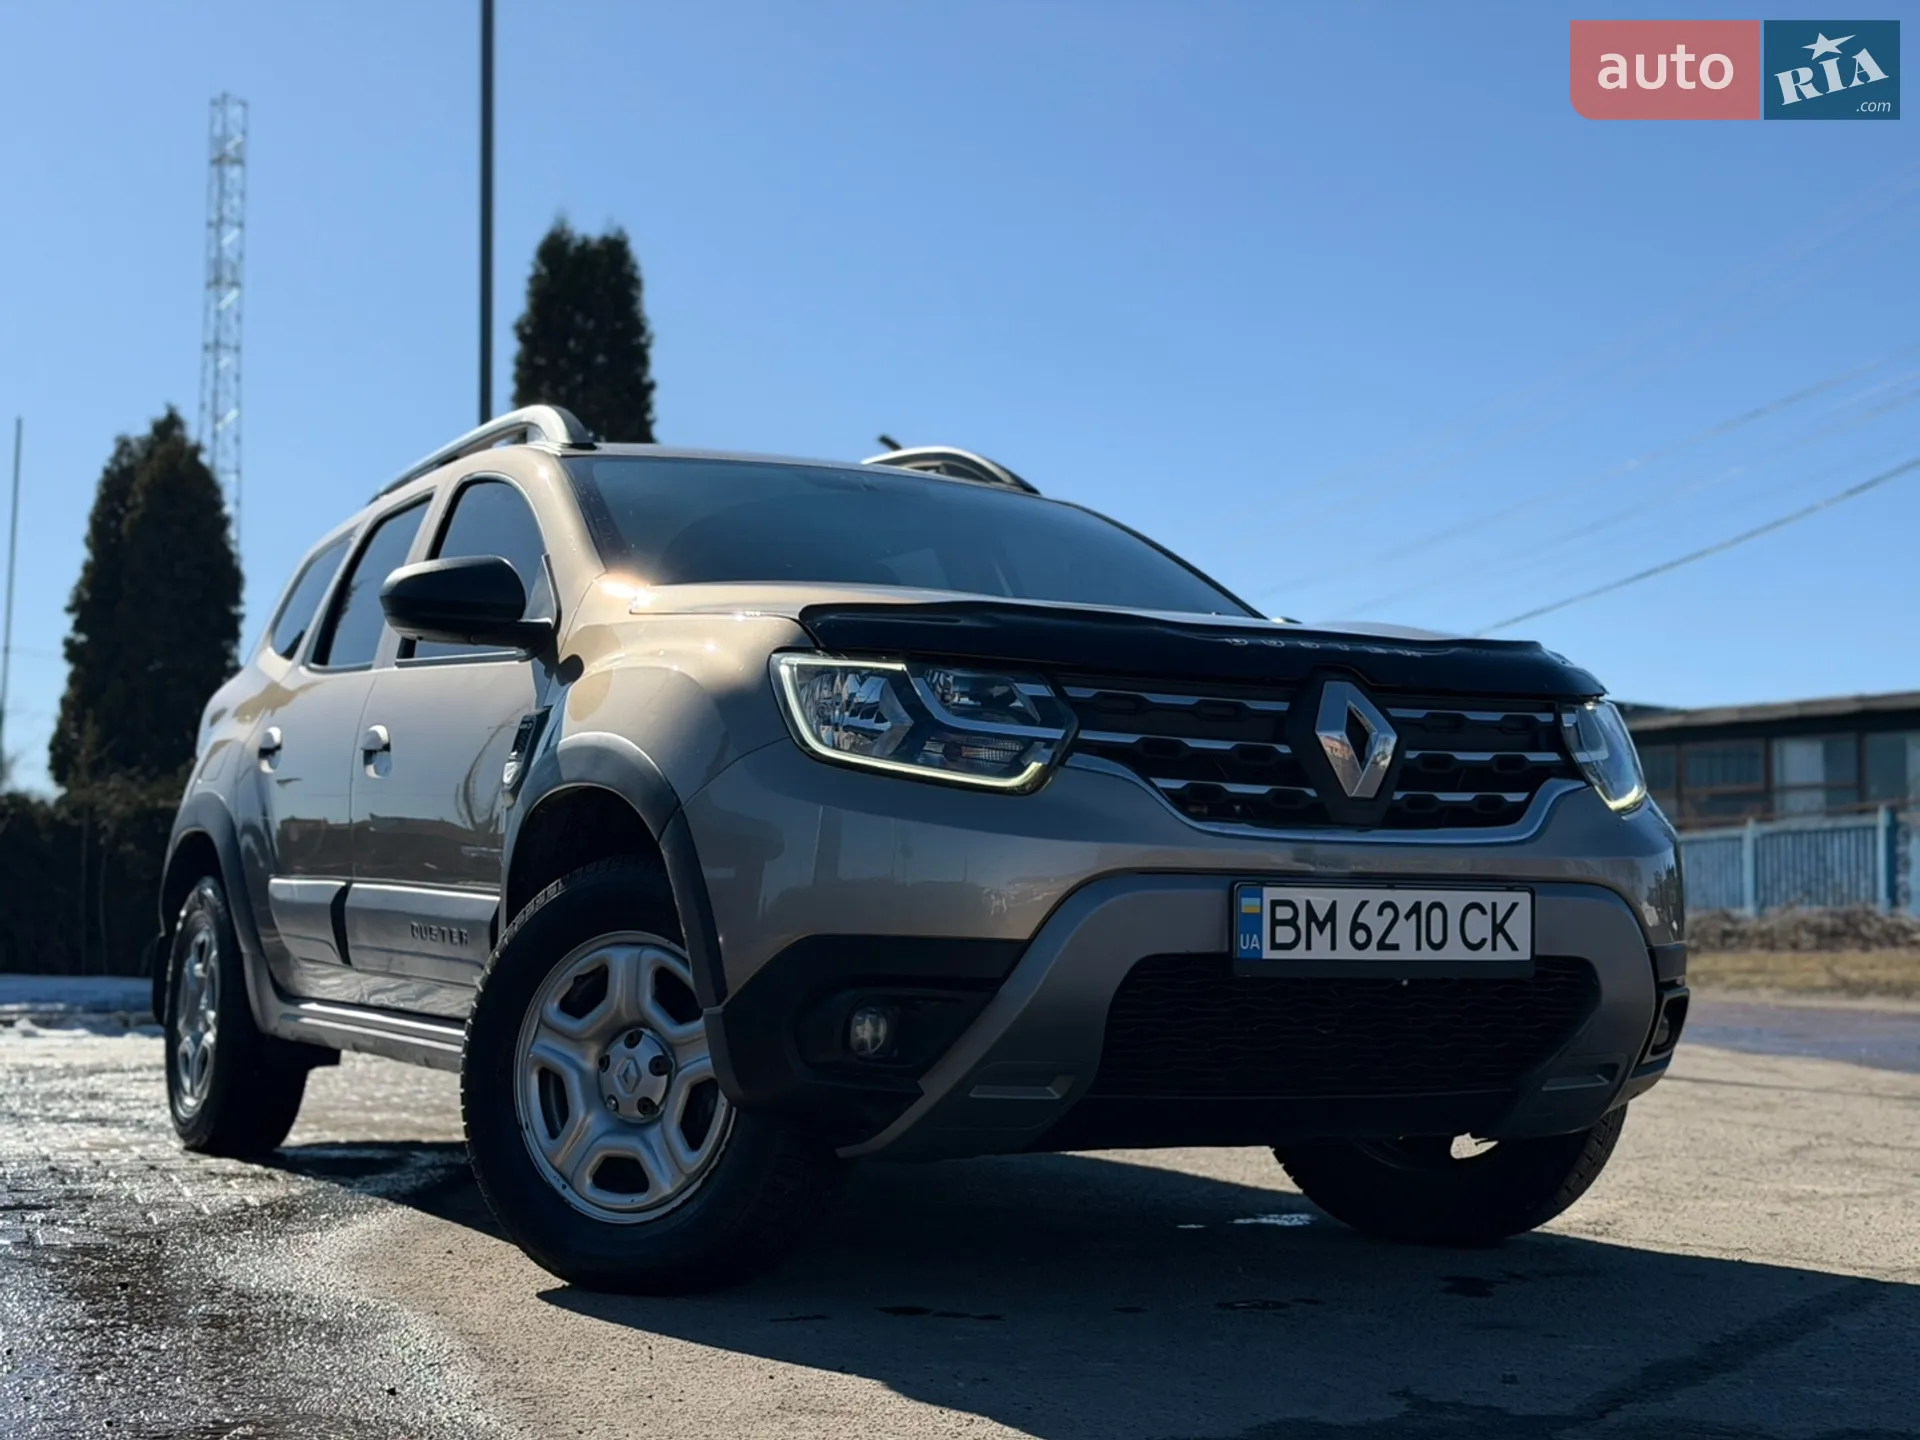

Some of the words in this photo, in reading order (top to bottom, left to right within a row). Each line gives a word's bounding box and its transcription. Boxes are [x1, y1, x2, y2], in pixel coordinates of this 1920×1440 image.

[410, 921, 469, 946] DUSTER
[1269, 899, 1337, 951] BM
[1349, 900, 1448, 951] 6210
[1459, 901, 1520, 952] CK
[1239, 933, 1260, 950] UA
